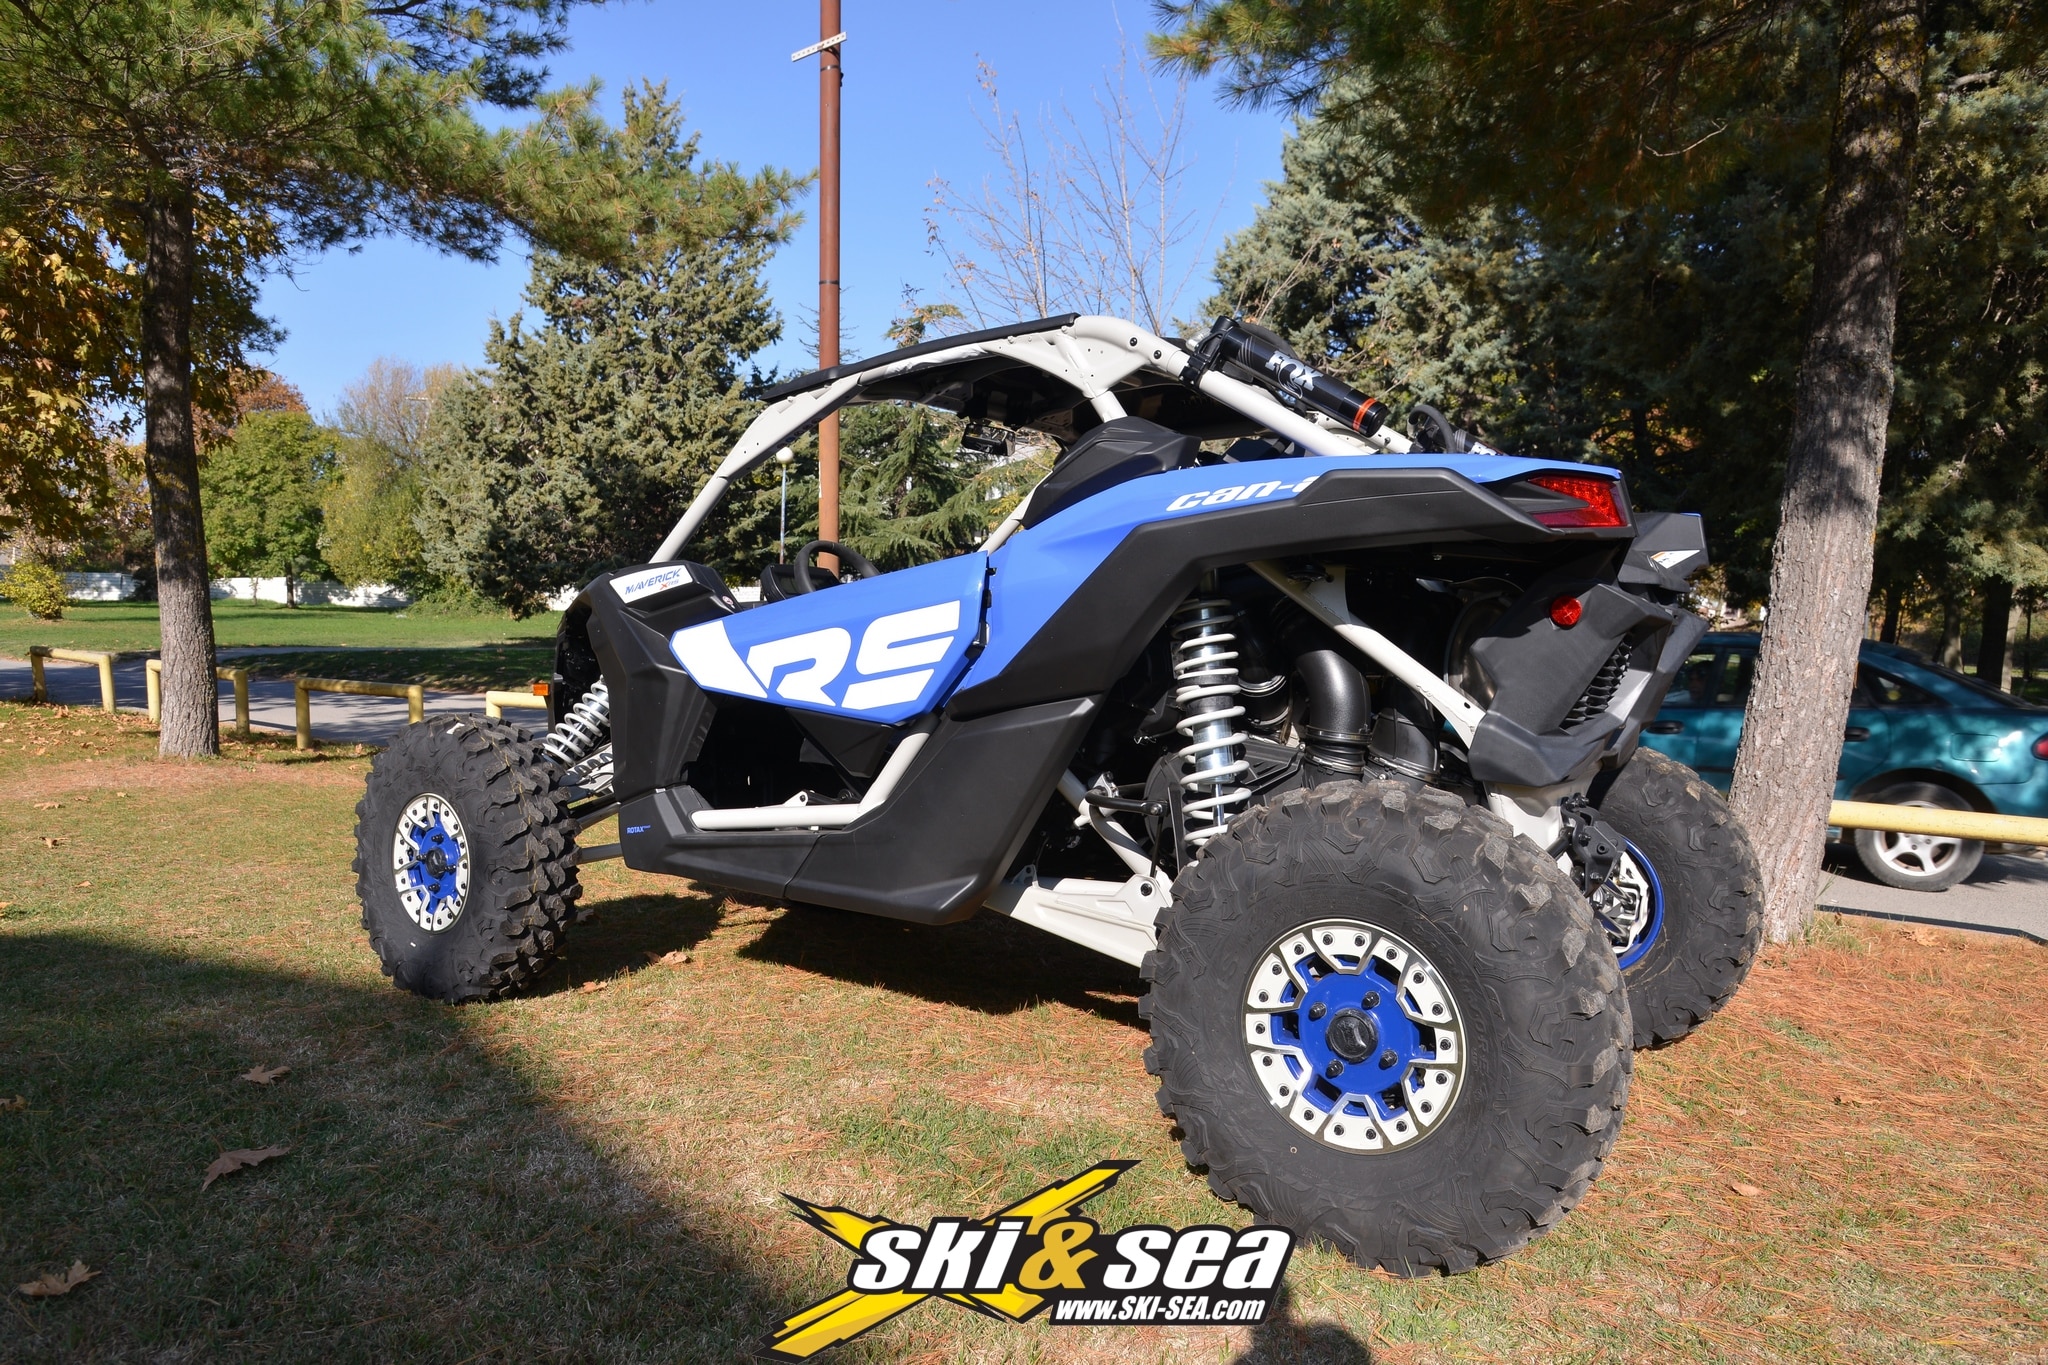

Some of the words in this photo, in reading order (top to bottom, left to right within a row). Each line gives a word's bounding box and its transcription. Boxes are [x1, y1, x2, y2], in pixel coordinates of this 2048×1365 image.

[1265, 350, 1324, 396] FOX
[625, 568, 682, 595] MAVERICK
[746, 600, 961, 711] RS
[626, 826, 645, 834] ROTAX
